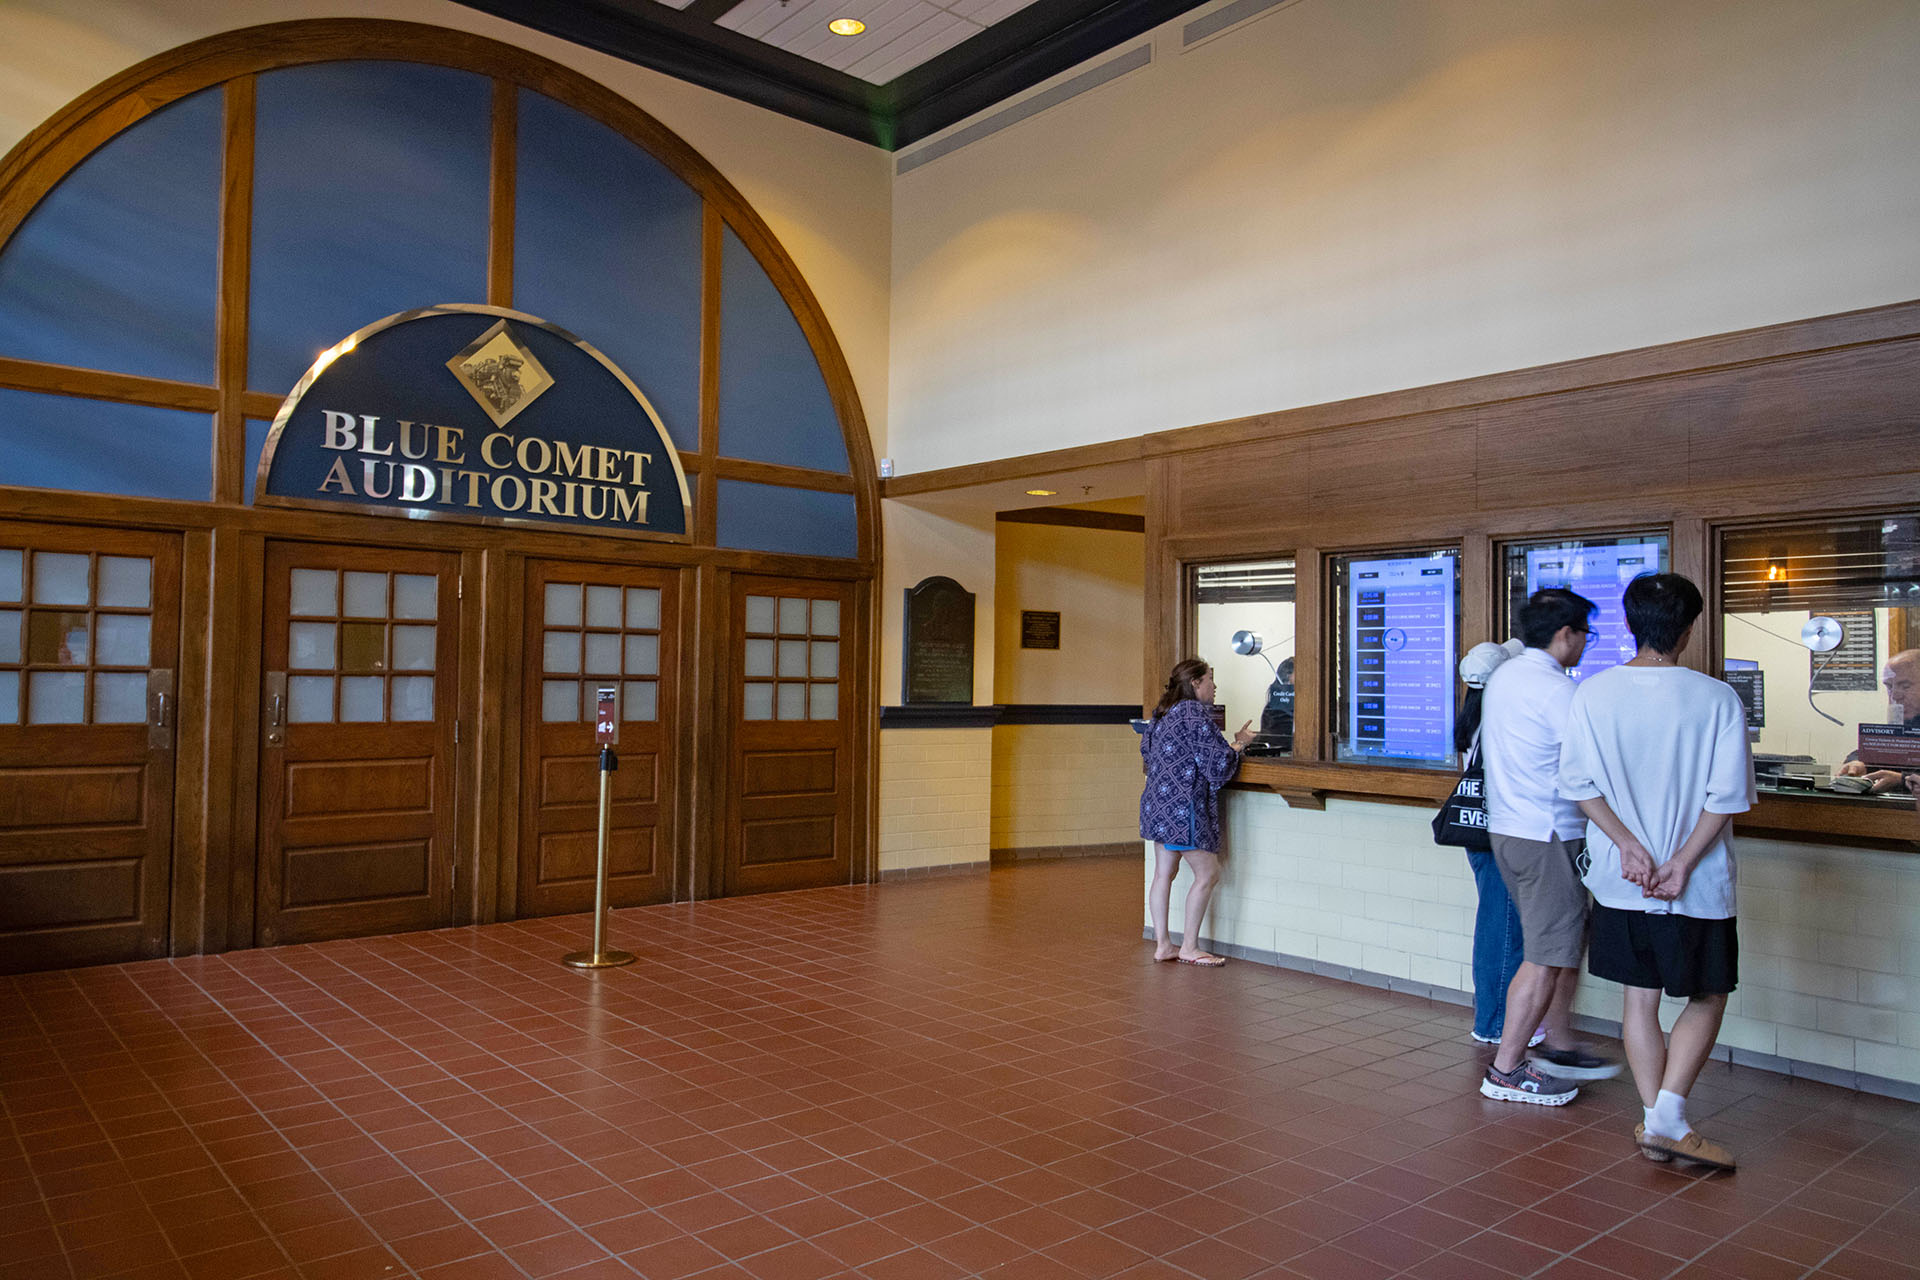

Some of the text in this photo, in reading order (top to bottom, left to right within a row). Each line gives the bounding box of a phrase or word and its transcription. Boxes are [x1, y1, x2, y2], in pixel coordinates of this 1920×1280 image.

[320, 409, 652, 487] BLUE COMET
[317, 455, 651, 525] AUDITORIUM
[1457, 780, 1480, 796] THE
